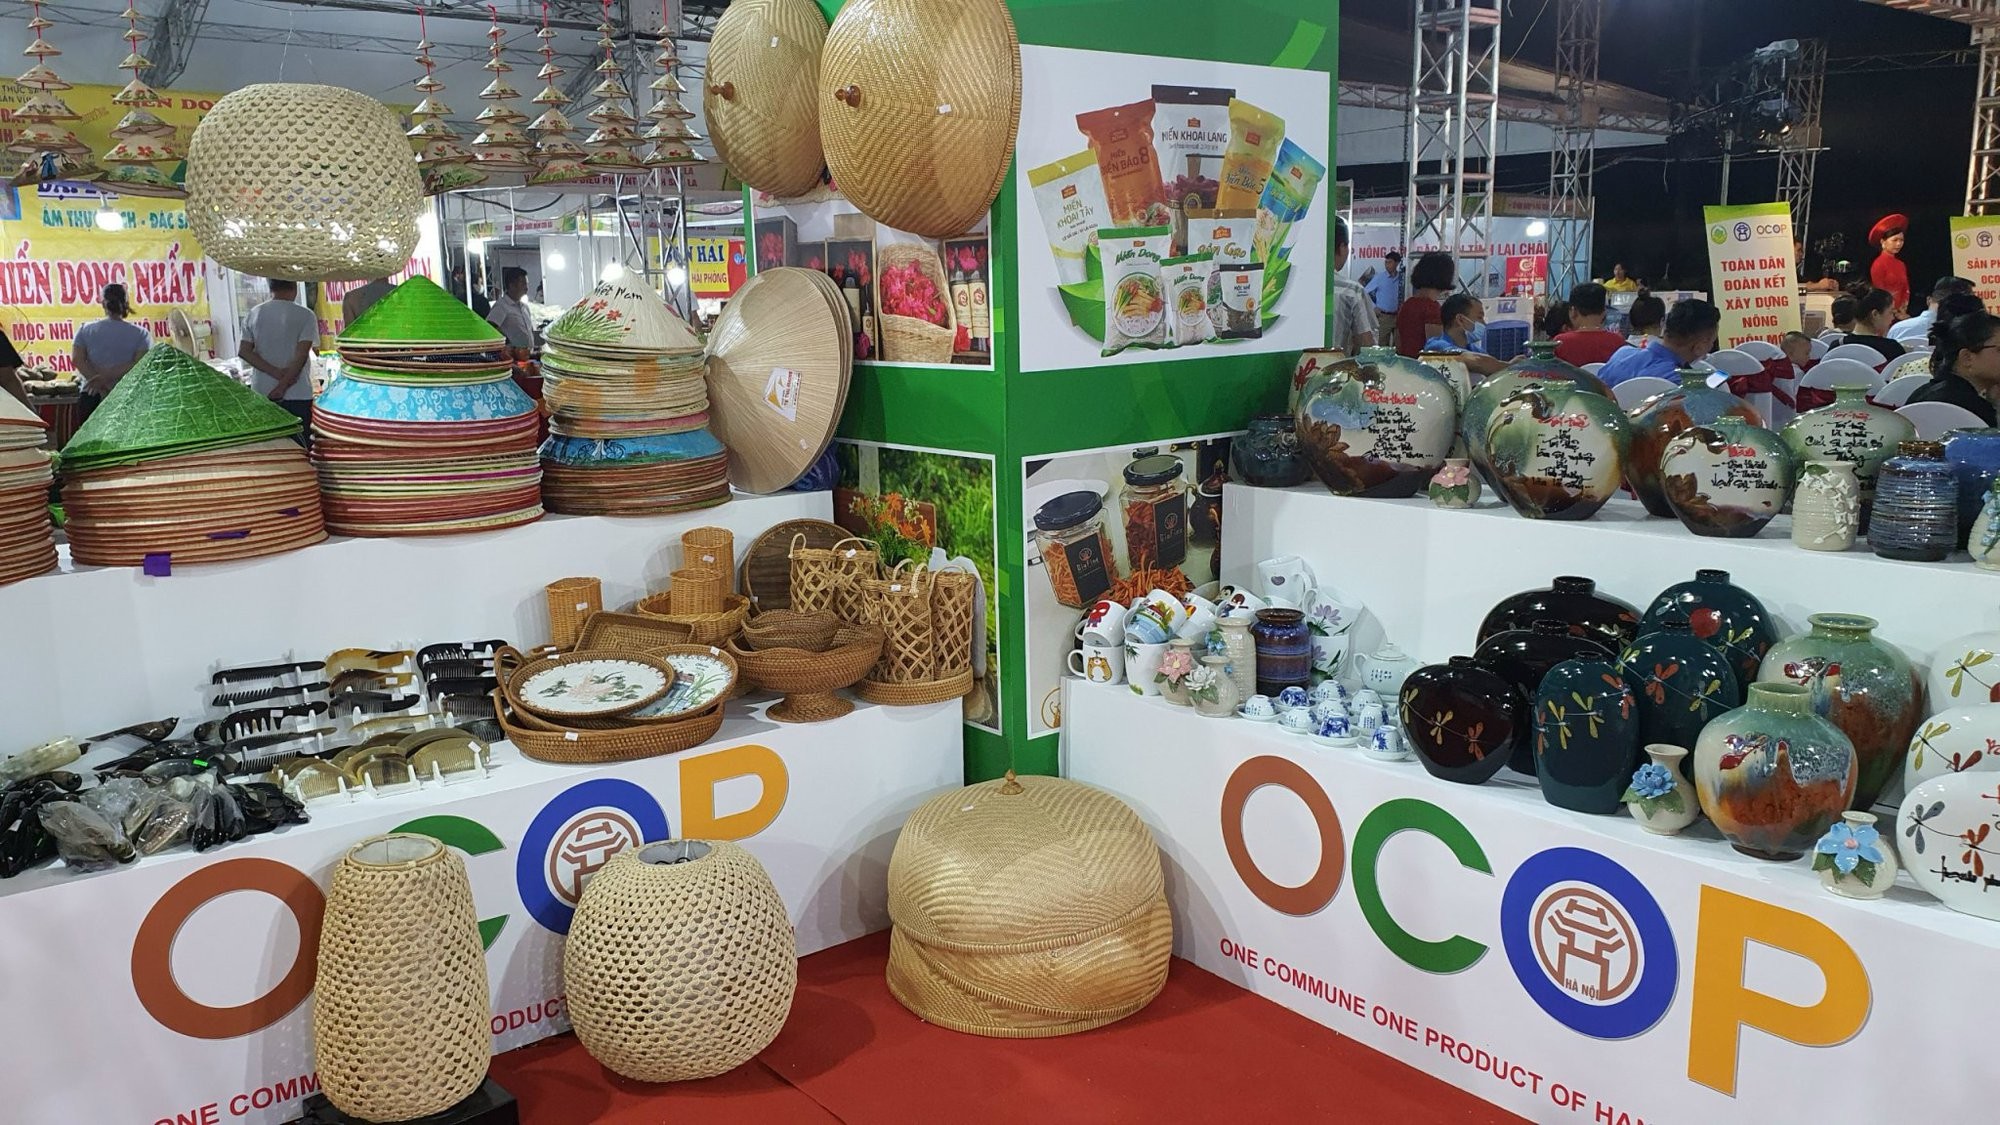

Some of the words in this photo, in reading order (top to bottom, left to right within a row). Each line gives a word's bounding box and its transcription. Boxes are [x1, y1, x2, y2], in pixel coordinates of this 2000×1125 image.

[1181, 130, 1206, 141] KHOAI
[1207, 131, 1227, 143] LANG
[1756, 223, 1788, 235] OCOP
[1497, 243, 1516, 256] LAI
[1720, 257, 1756, 272] TOÀN
[1759, 255, 1786, 270] DÂN
[132, 242, 196, 305] NHẤT
[1724, 275, 1761, 291] ĐOÀN
[1764, 273, 1787, 288] KẾT
[1725, 296, 1751, 311] XÂY
[1755, 295, 1789, 311] DỰNG
[1742, 313, 1778, 328] NÔNG
[1221, 755, 1873, 1098] OCOP
[1565, 977, 1579, 993] HÀ
[1220, 937, 1259, 970] ONE
[1263, 957, 1367, 1018] COMMUNE
[1372, 1004, 1418, 1042] ONE
[1424, 1026, 1544, 1095] PRODUCT
[1550, 1083, 1587, 1112] OF
